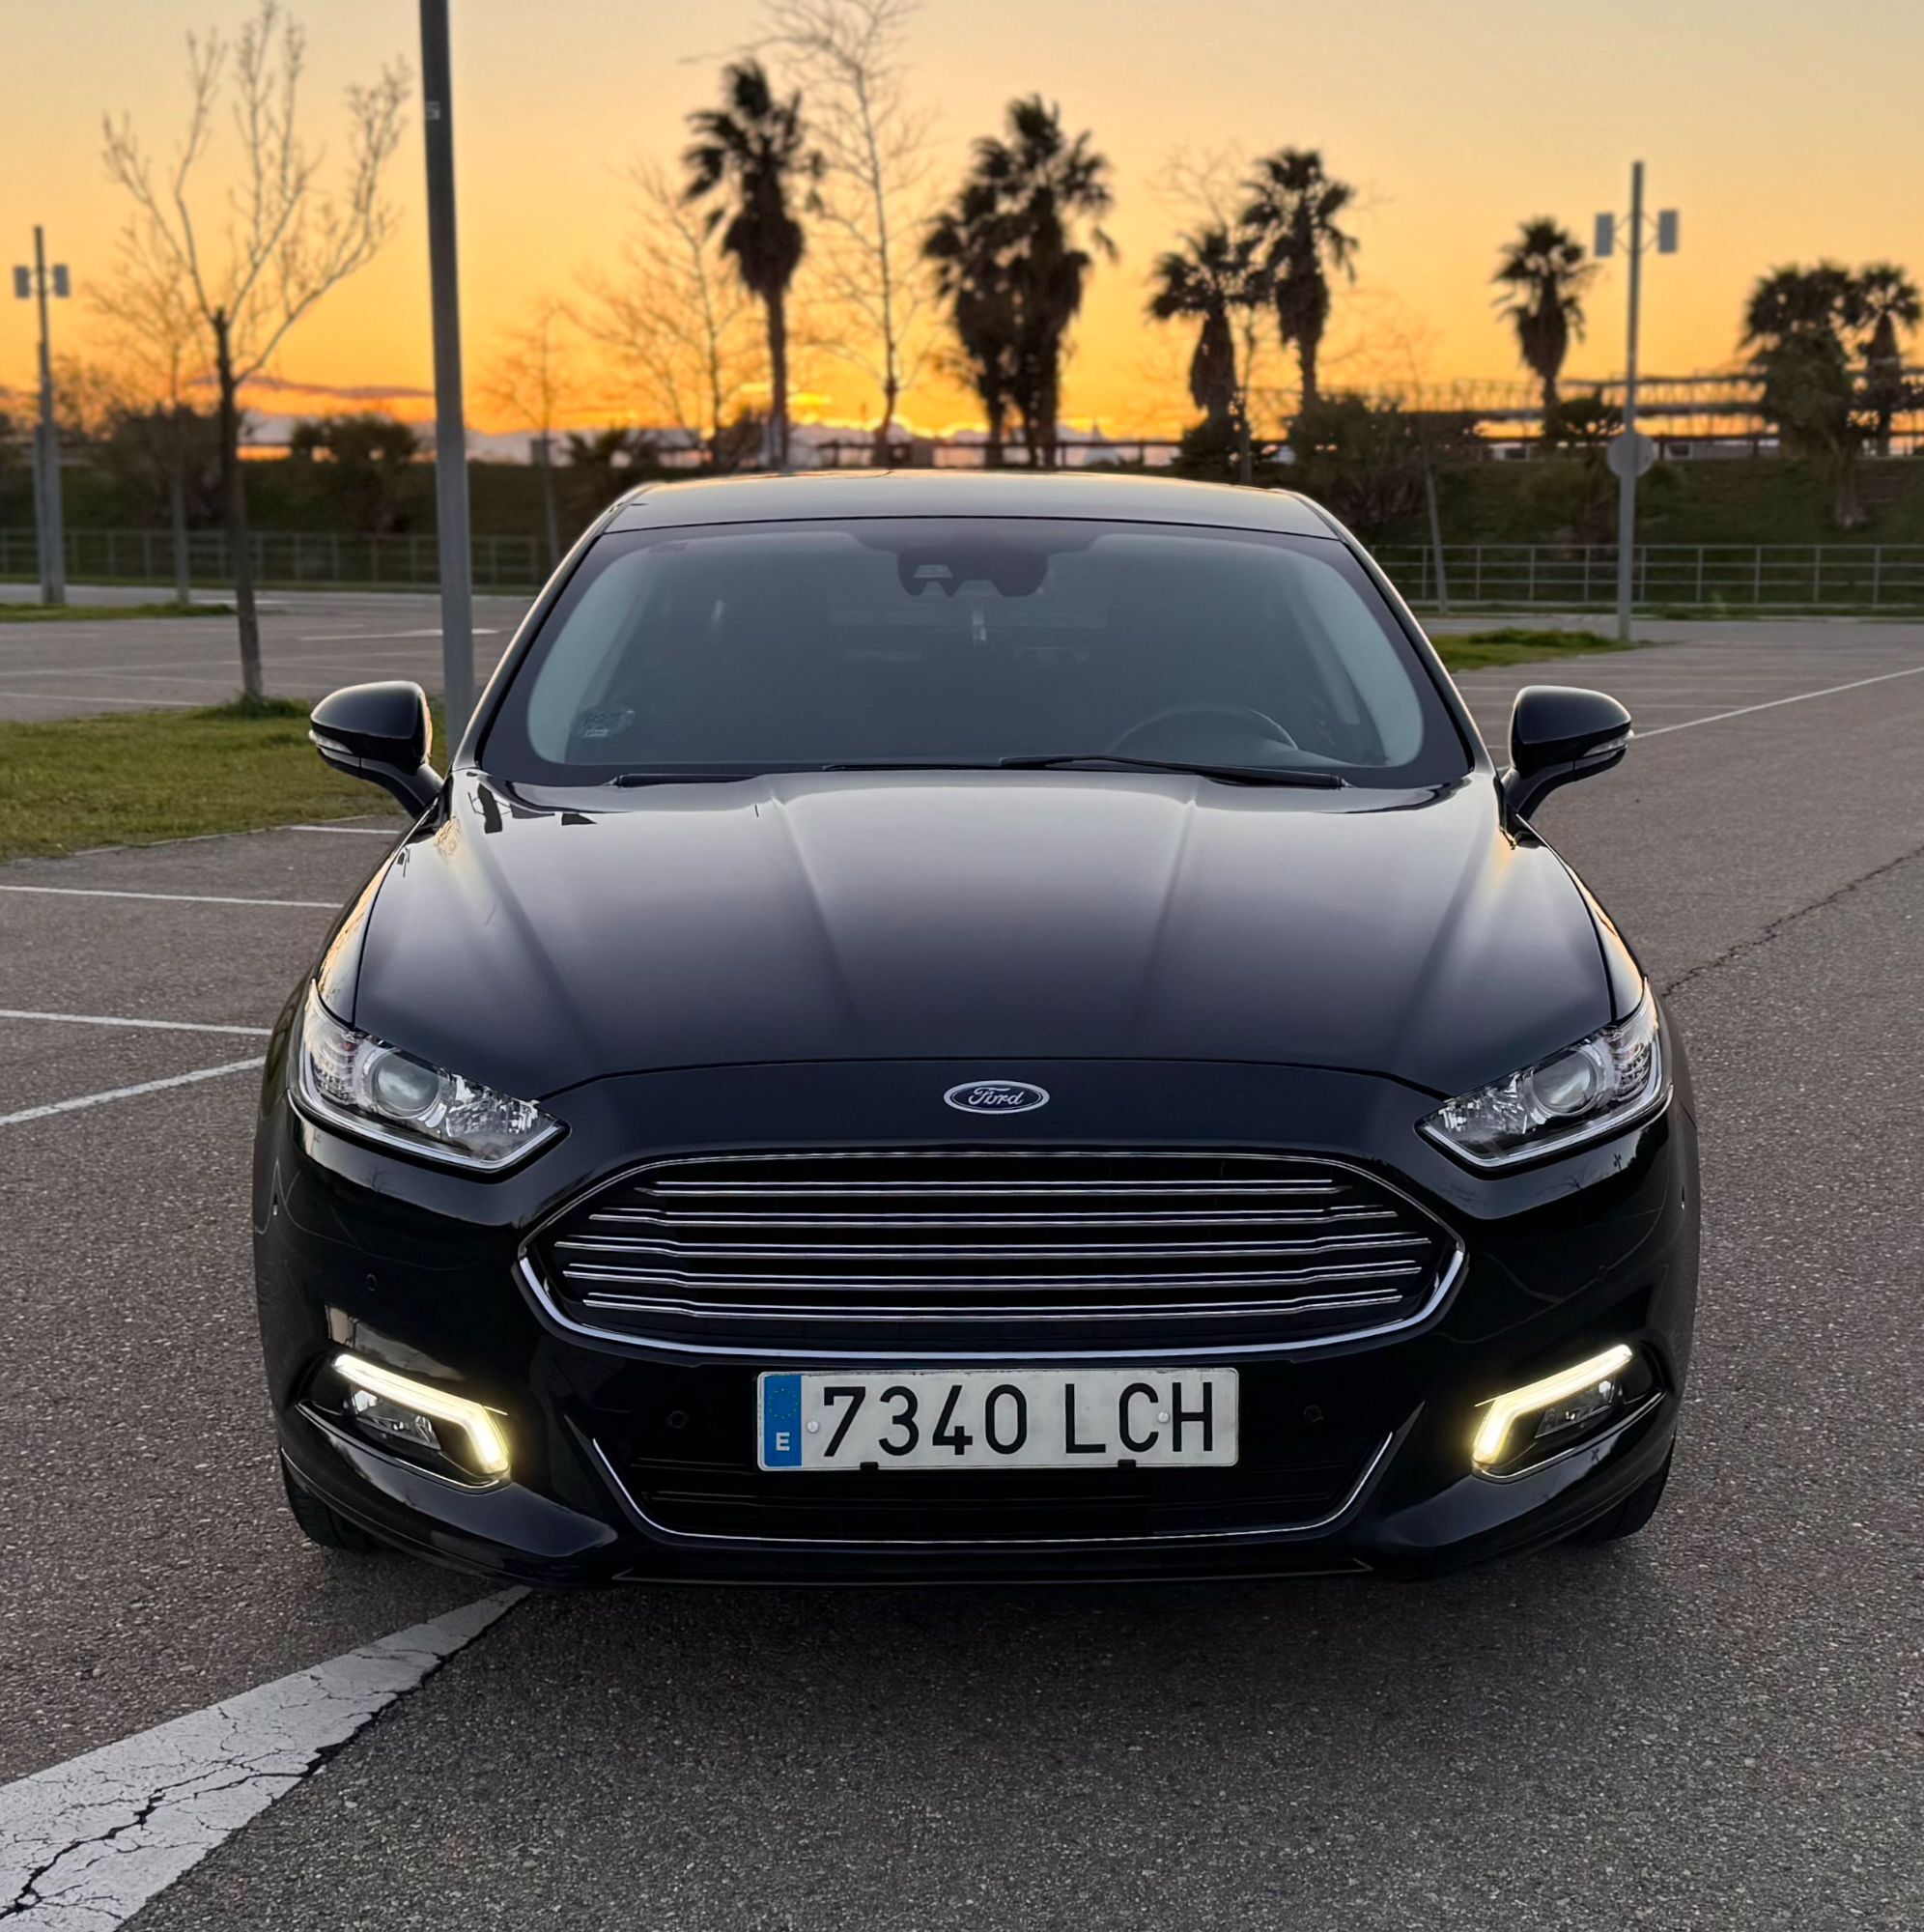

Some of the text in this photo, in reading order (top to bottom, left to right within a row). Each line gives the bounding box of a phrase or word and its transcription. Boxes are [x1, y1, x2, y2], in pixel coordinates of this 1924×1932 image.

[968, 1087, 1025, 1105] Ford
[824, 1381, 1213, 1457] 7340 LCH
[776, 1432, 790, 1451] E
